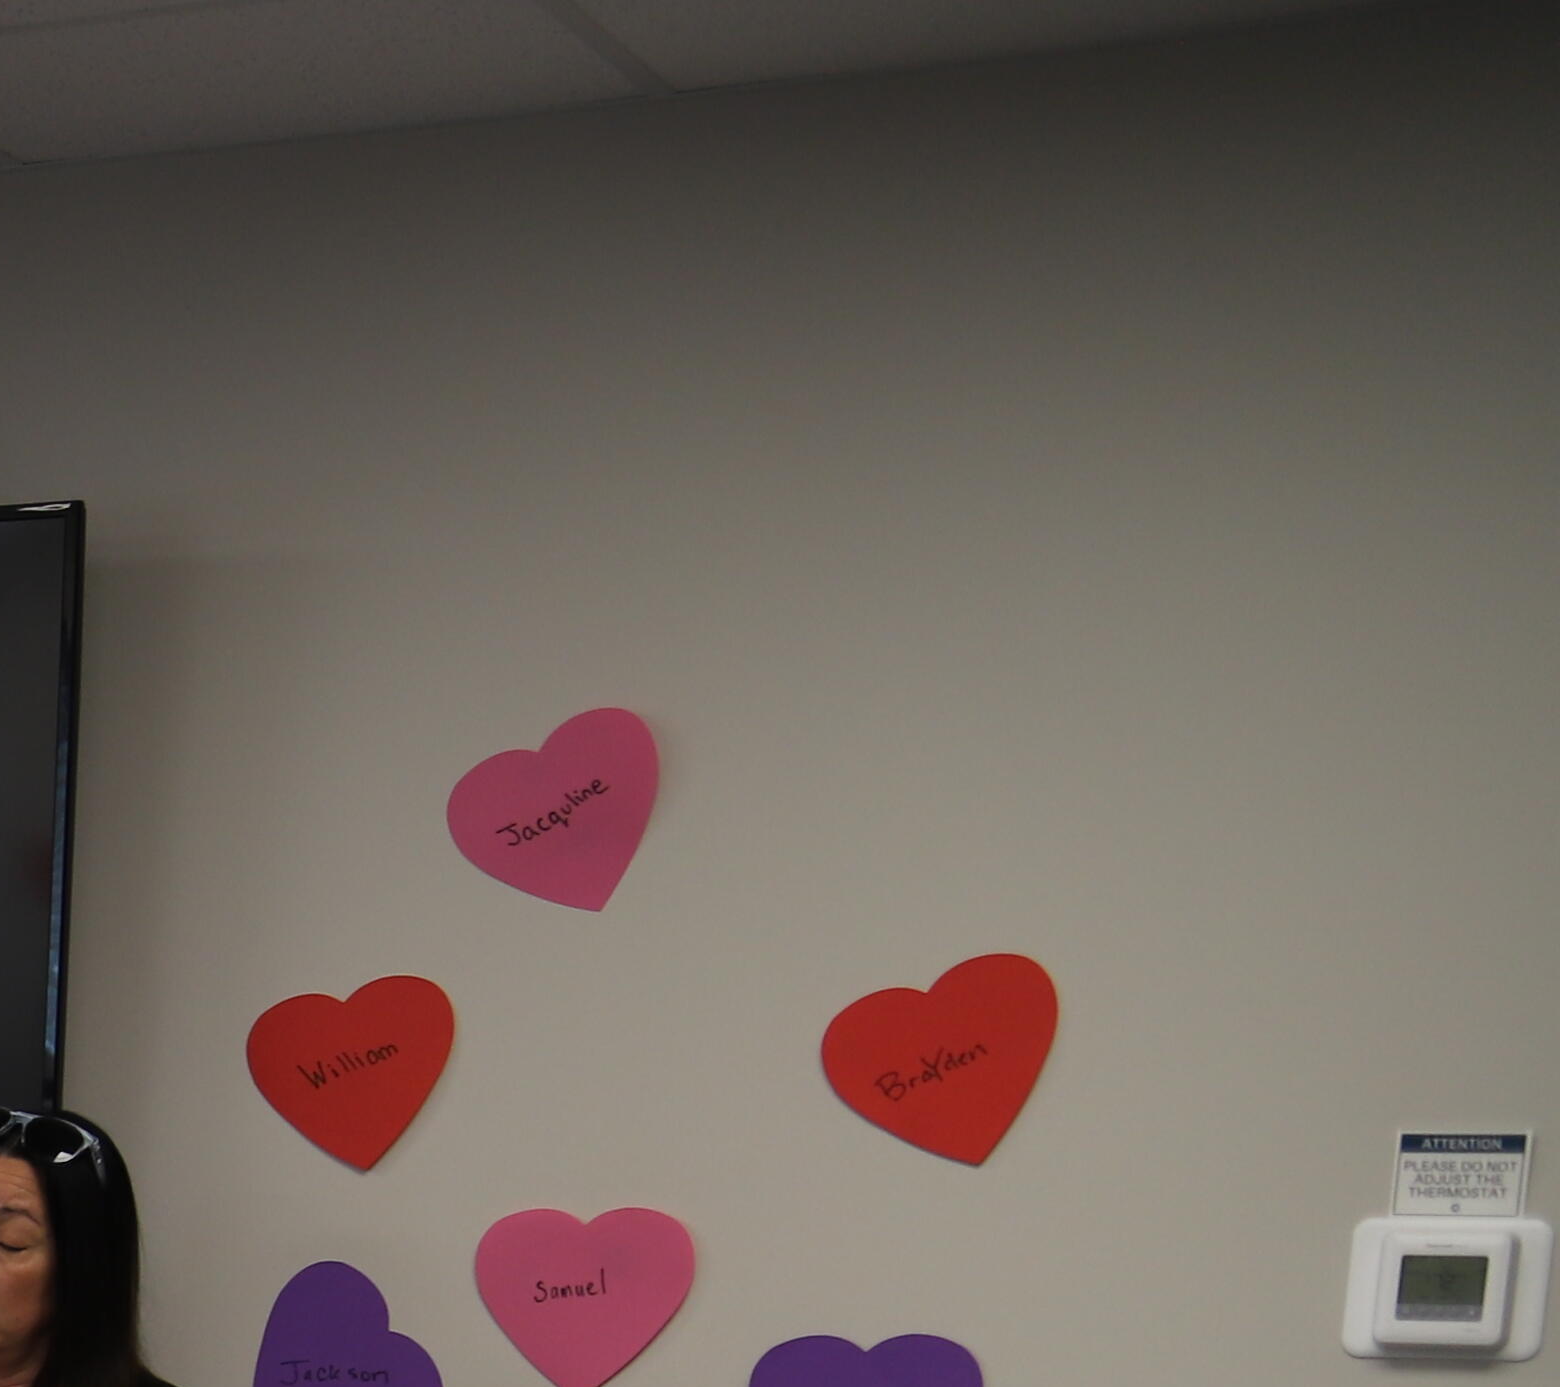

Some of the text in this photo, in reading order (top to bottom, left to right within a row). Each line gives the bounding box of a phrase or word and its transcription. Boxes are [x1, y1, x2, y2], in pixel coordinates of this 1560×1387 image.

[296, 1038, 399, 1092] William
[1421, 1138, 1503, 1150] ATTENTION
[1403, 1160, 1518, 1172] PLEASE DO NOT
[1414, 1174, 1504, 1186] ADJUST THE
[1408, 1187, 1508, 1199] THERMOSTAT
[279, 1358, 390, 1387] Jackson
